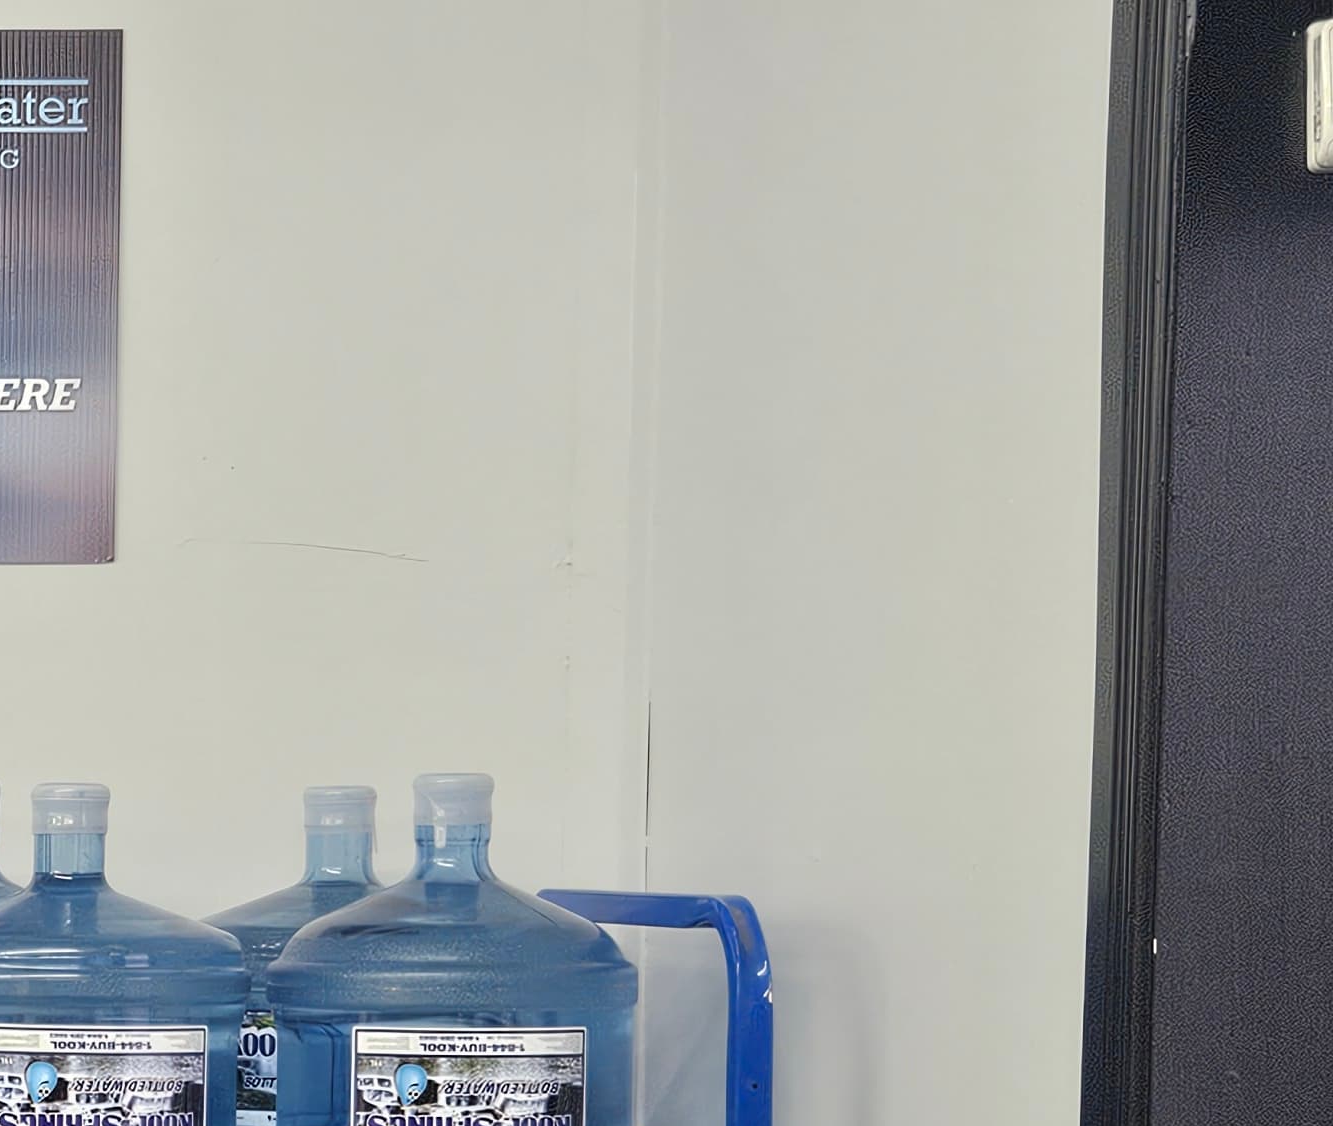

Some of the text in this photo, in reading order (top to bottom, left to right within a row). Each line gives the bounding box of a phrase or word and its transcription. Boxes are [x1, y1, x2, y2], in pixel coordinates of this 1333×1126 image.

[70, 1077, 184, 1092] BOTTLED WATER
[444, 1079, 560, 1095] BOTTLED WATER
